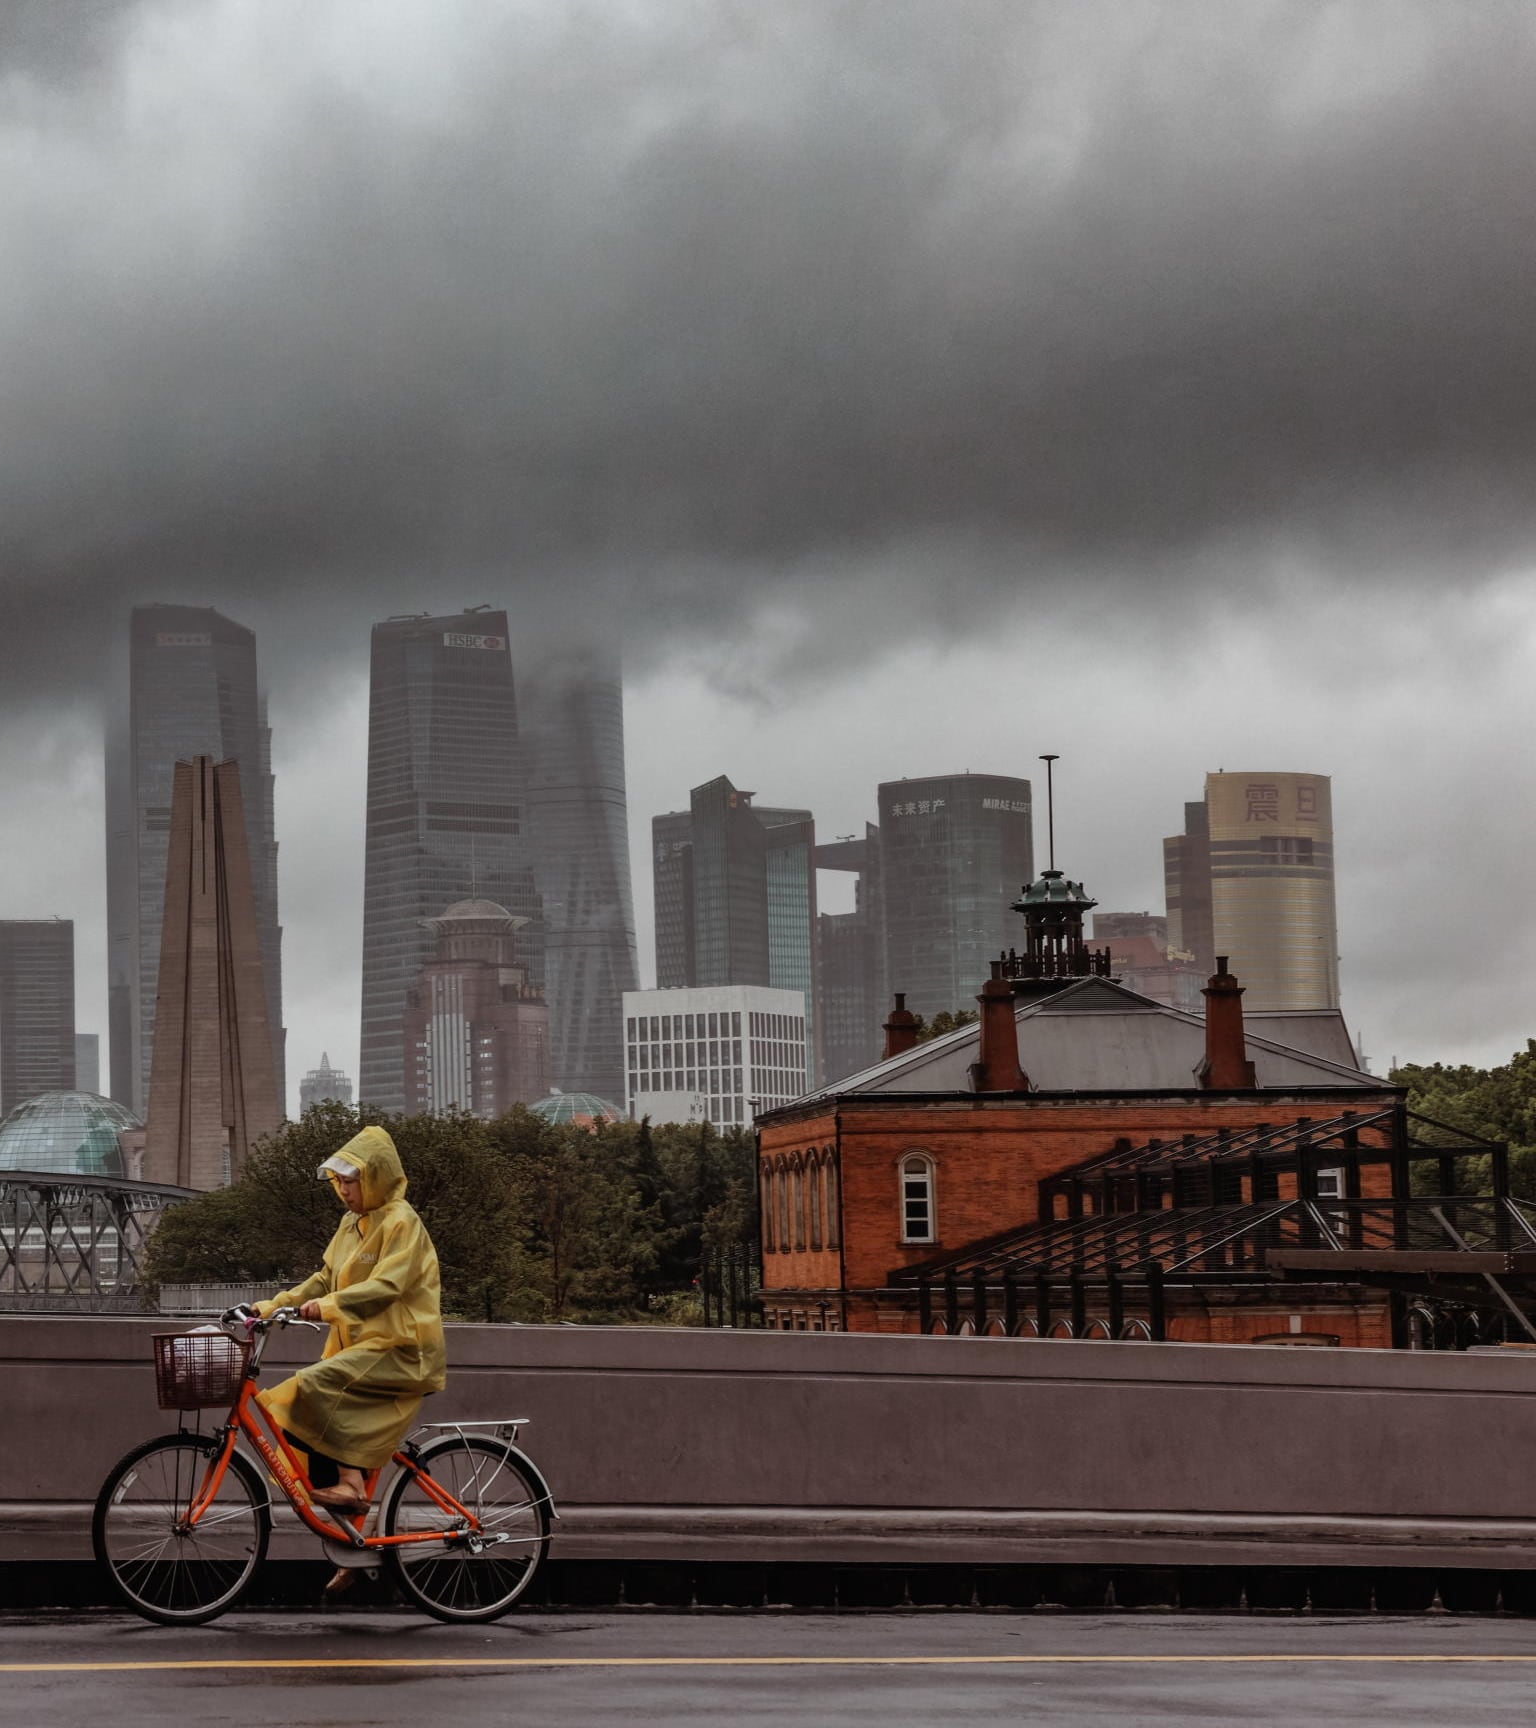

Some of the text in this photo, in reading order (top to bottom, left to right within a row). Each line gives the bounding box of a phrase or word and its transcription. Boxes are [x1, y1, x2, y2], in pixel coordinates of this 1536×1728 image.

[448, 633, 482, 648] HSBC
[892, 799, 946, 817] 未来资产
[982, 798, 1010, 811] MIRAE
[1245, 783, 1319, 822] 震旦
